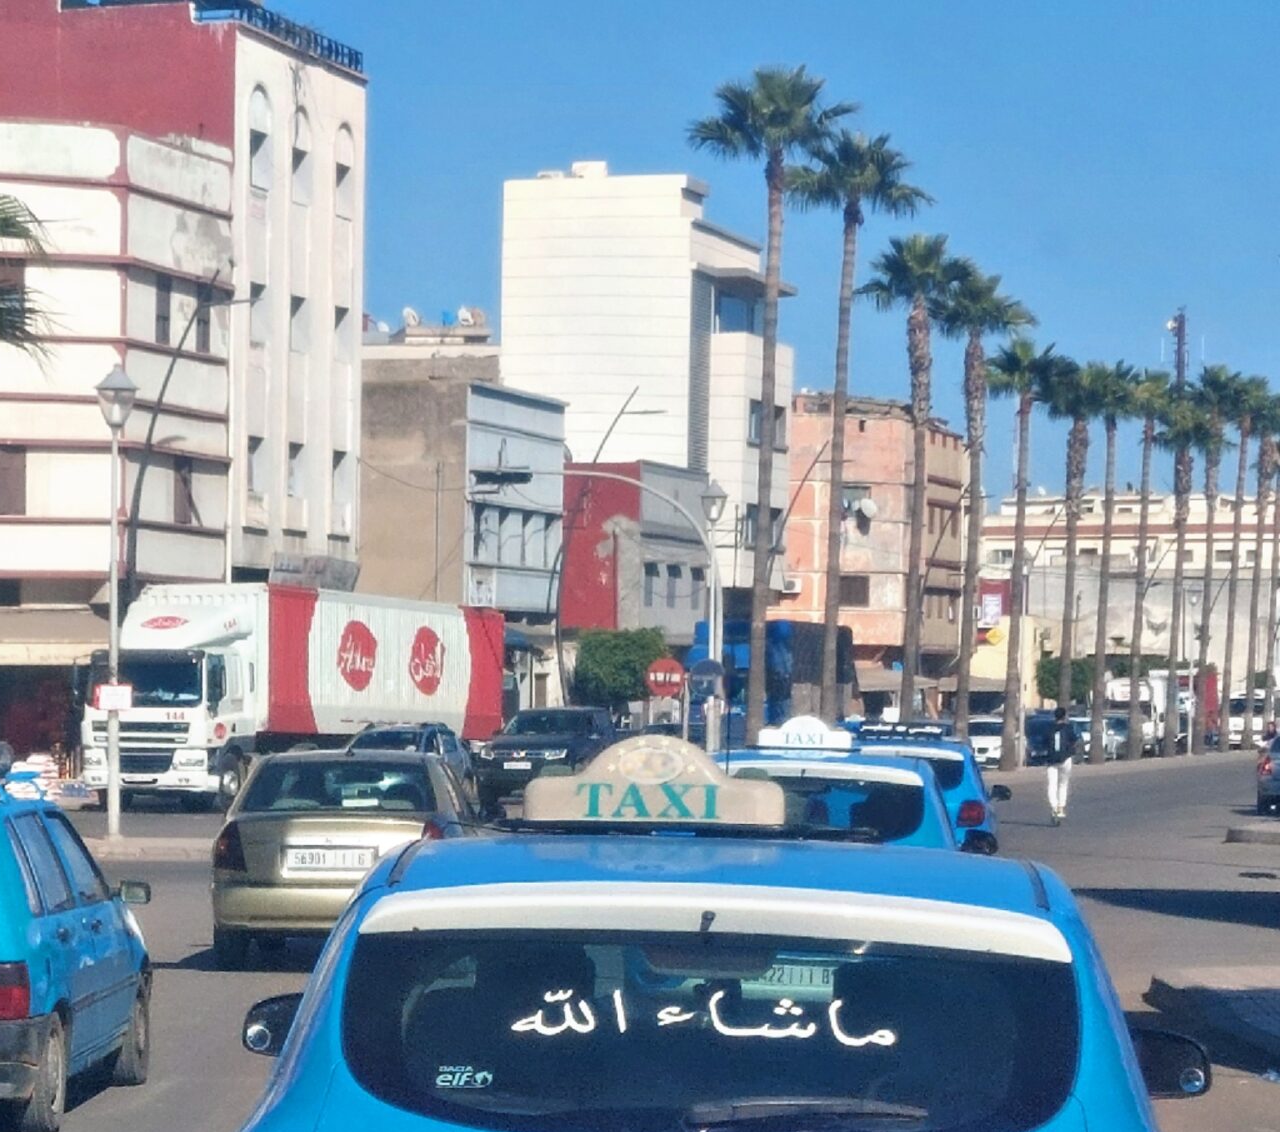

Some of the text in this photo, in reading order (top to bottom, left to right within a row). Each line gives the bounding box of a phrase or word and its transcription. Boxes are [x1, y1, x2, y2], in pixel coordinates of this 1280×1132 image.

[165, 711, 185, 720] 144
[784, 733, 824, 745] TAXI
[577, 782, 720, 819] TAXI
[435, 1072, 474, 1086] elf
